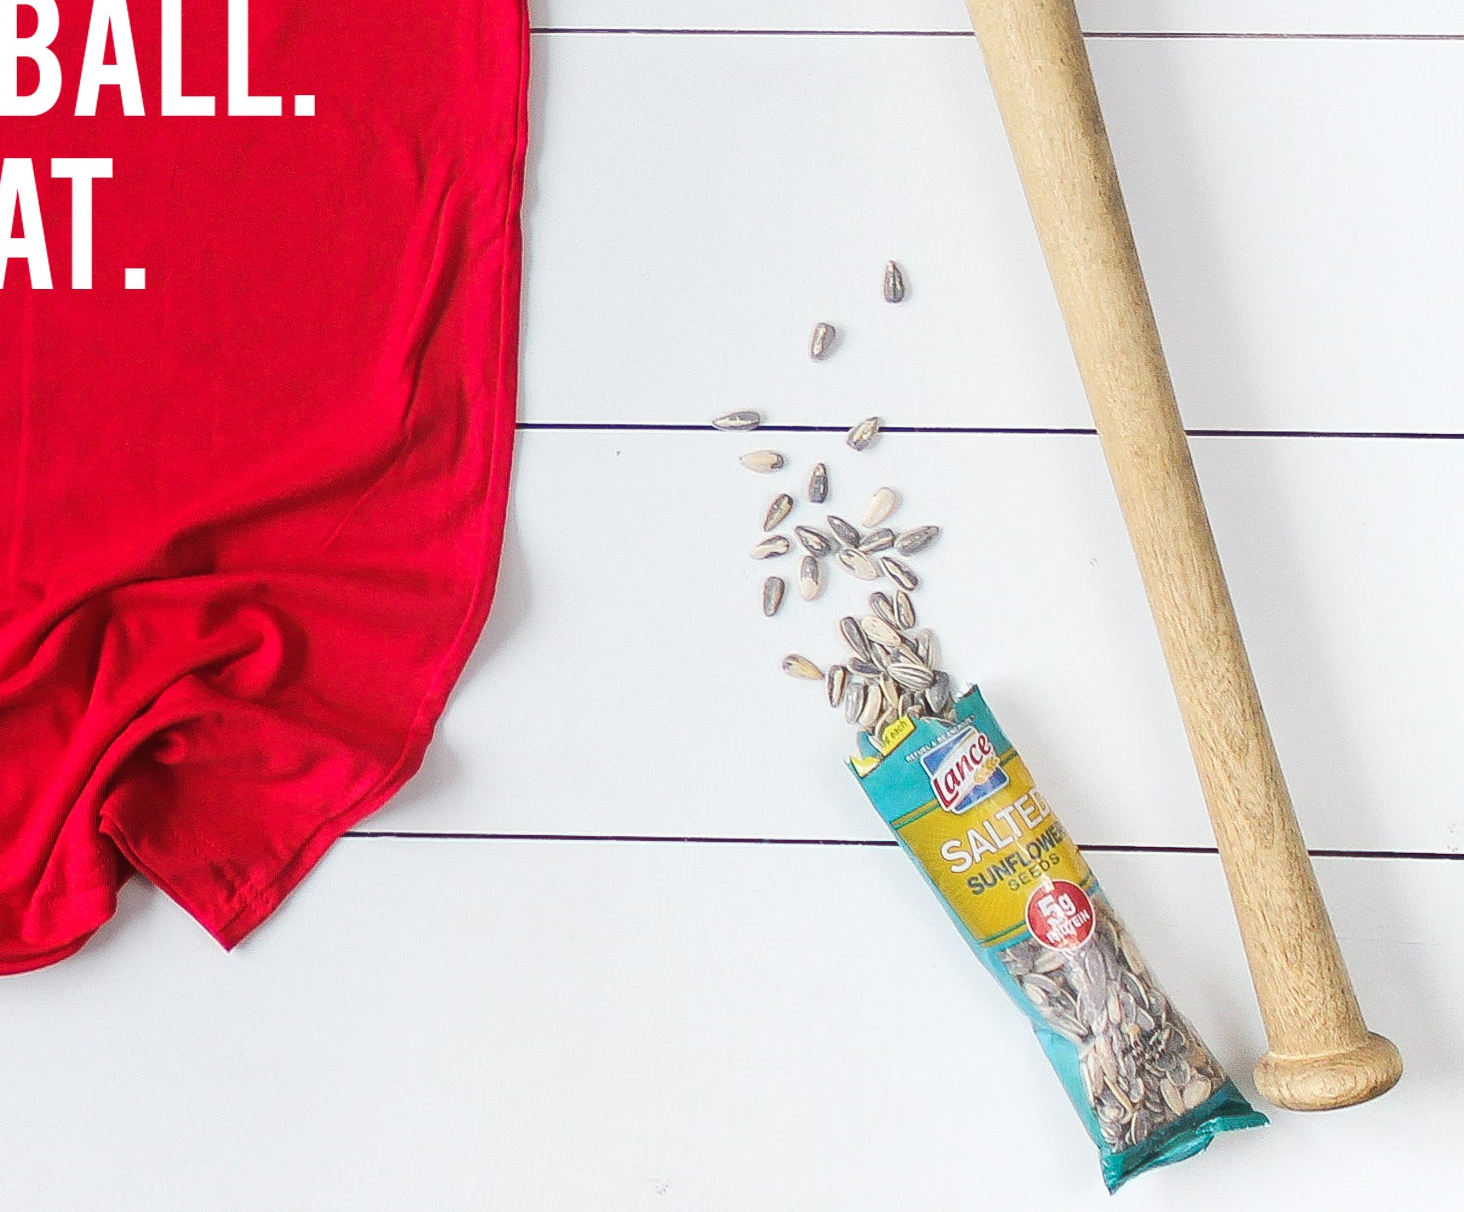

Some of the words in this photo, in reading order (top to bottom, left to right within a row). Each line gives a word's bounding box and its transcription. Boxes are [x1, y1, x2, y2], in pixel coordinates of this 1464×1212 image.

[933, 734, 992, 808] Lance
[1008, 853, 1060, 891] SEEDS
[1038, 893, 1077, 927] 5g
